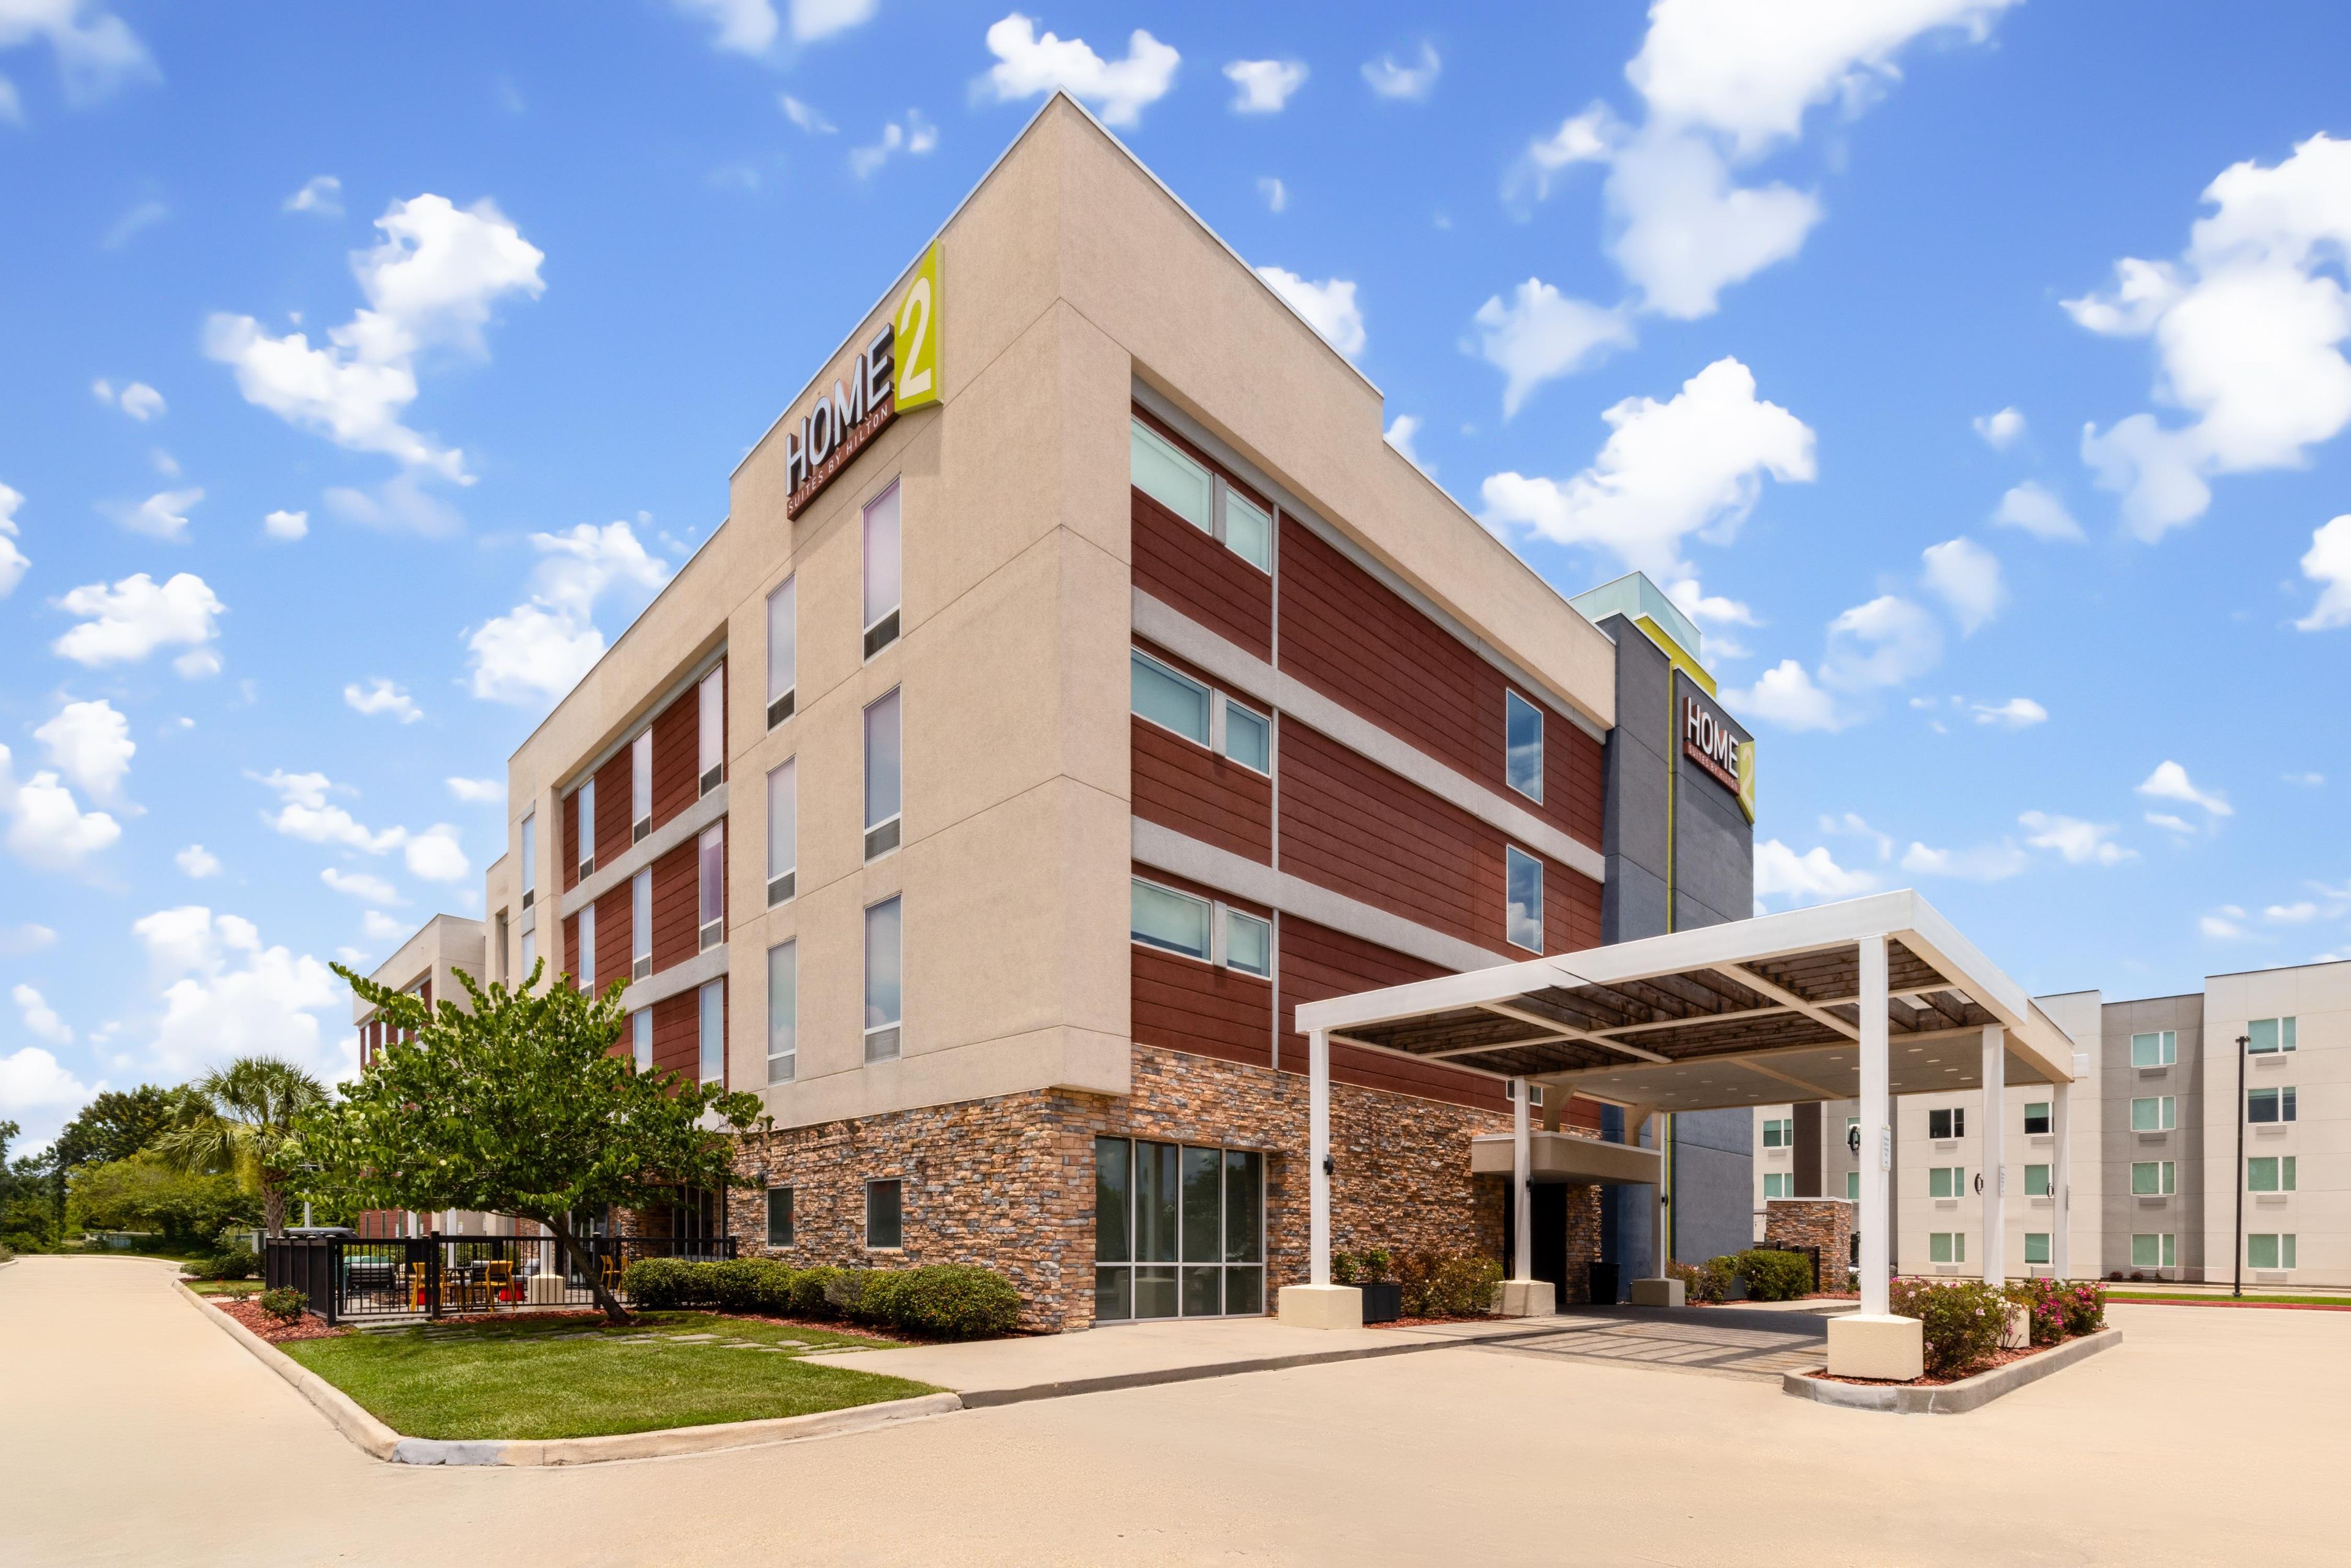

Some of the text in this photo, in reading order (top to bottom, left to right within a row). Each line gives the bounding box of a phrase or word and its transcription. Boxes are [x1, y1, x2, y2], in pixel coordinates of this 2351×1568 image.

[786, 277, 931, 497] HOME 2
[789, 405, 888, 513] SUITES BY HILTON
[1688, 696, 1754, 812] HOME 2
[1689, 745, 1738, 790] SUITES BY HILTON
